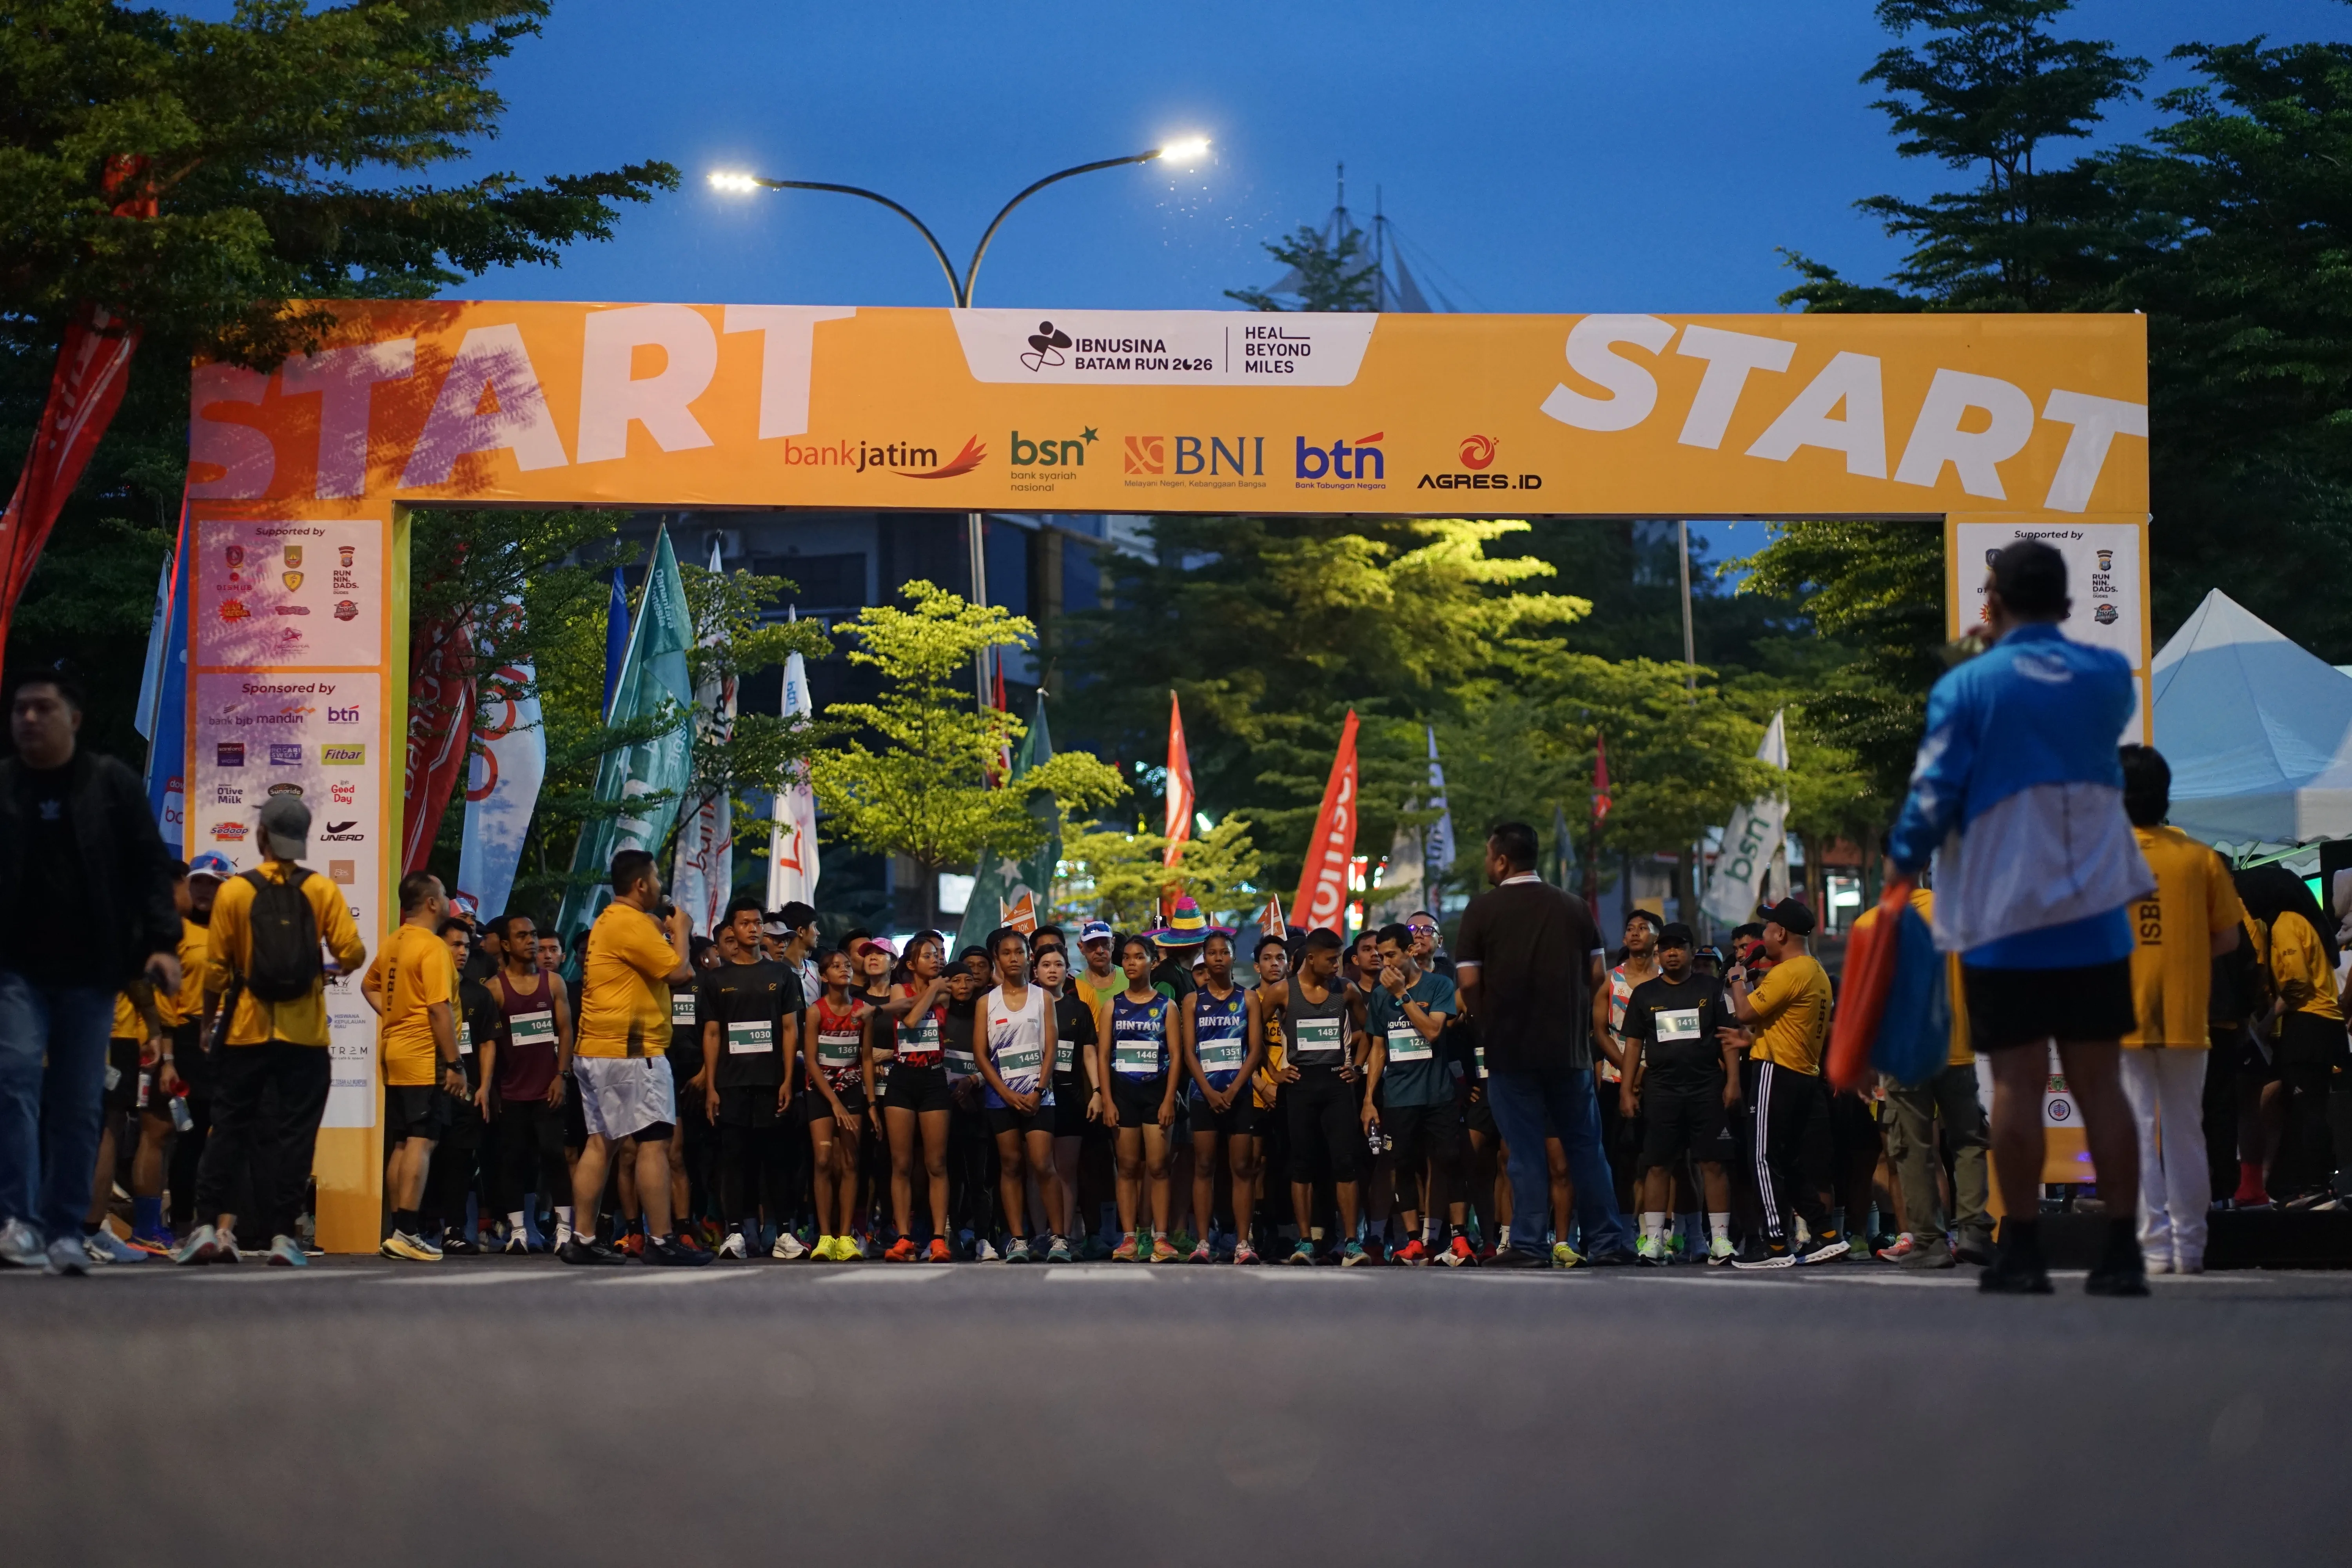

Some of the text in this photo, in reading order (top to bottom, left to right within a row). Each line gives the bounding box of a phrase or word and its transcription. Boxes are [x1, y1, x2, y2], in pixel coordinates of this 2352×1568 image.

[1245, 327, 1310, 339] HEAL
[1076, 339, 1166, 353] IBNUSINA
[1246, 343, 1310, 356] BEYOND
[1075, 358, 1212, 370] BATAM RUN 2026
[1246, 361, 1294, 373] MILES
[188, 305, 857, 501] START
[1539, 313, 2148, 513] START
[1011, 430, 1084, 466] bsn
[1174, 436, 1265, 477] BNI
[1296, 432, 1384, 479] btn
[1039, 472, 1076, 482] syariah
[1417, 474, 1542, 490] AGRES.ID
[1011, 483, 1054, 492] nasional
[256, 528, 326, 537] Supported by
[2014, 530, 2083, 540] Supported by
[655, 568, 673, 629] Danantara
[242, 683, 336, 695] Sponsored by
[328, 705, 359, 721] btn
[209, 716, 253, 727] bank bjb
[325, 749, 362, 760] Fitbar
[331, 784, 355, 793] Good
[218, 796, 241, 804] Milk
[334, 794, 352, 804] Day
[1723, 817, 1770, 883] bsn
[1017, 922, 1029, 932] 10K
[2140, 897, 2162, 946] ISB
[532, 1020, 552, 1030] 1044
[1116, 1020, 1160, 1031] BINTAN
[1199, 1016, 1240, 1027] BINTAN
[1677, 1018, 1697, 1026] 1411
[750, 1031, 771, 1039] 1030
[917, 1029, 938, 1037] 1360
[1019, 1052, 1039, 1062] 1445
[1057, 1050, 1072, 1058] 157
